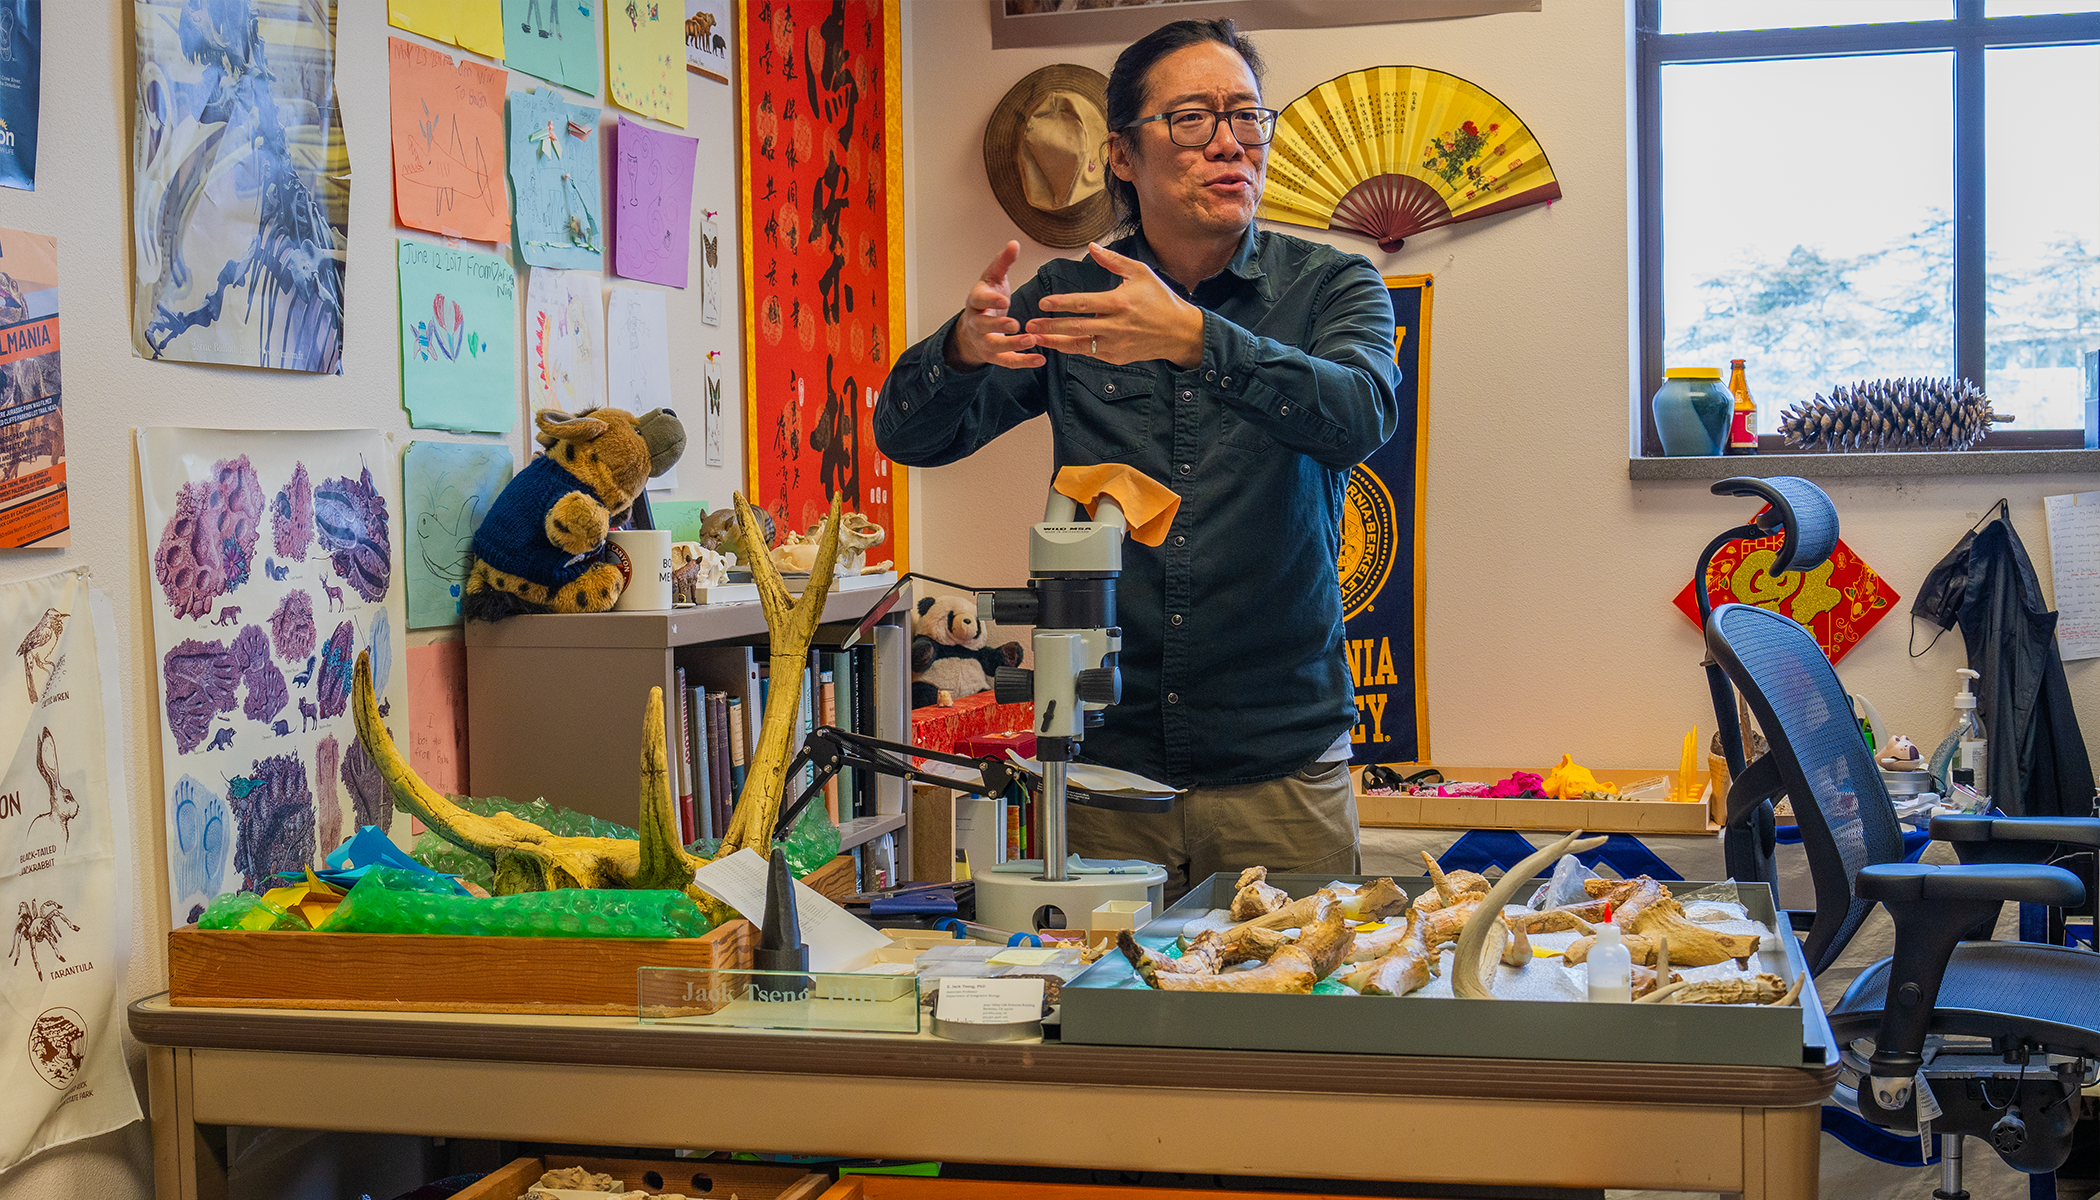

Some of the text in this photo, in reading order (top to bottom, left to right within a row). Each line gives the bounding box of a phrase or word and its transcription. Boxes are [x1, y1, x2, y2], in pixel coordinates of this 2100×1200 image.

[403, 242, 429, 265] June
[432, 250, 442, 270] 12
[445, 252, 462, 272] 2017
[611, 544, 631, 573] CANYON
[20, 844, 57, 864] BLACK-TAILED
[19, 858, 55, 877] JACKRABBIT
[50, 961, 94, 981] TARANTULA
[682, 981, 735, 1004] Jack
[828, 986, 876, 1008] PhD
[79, 1089, 94, 1100] PARK
